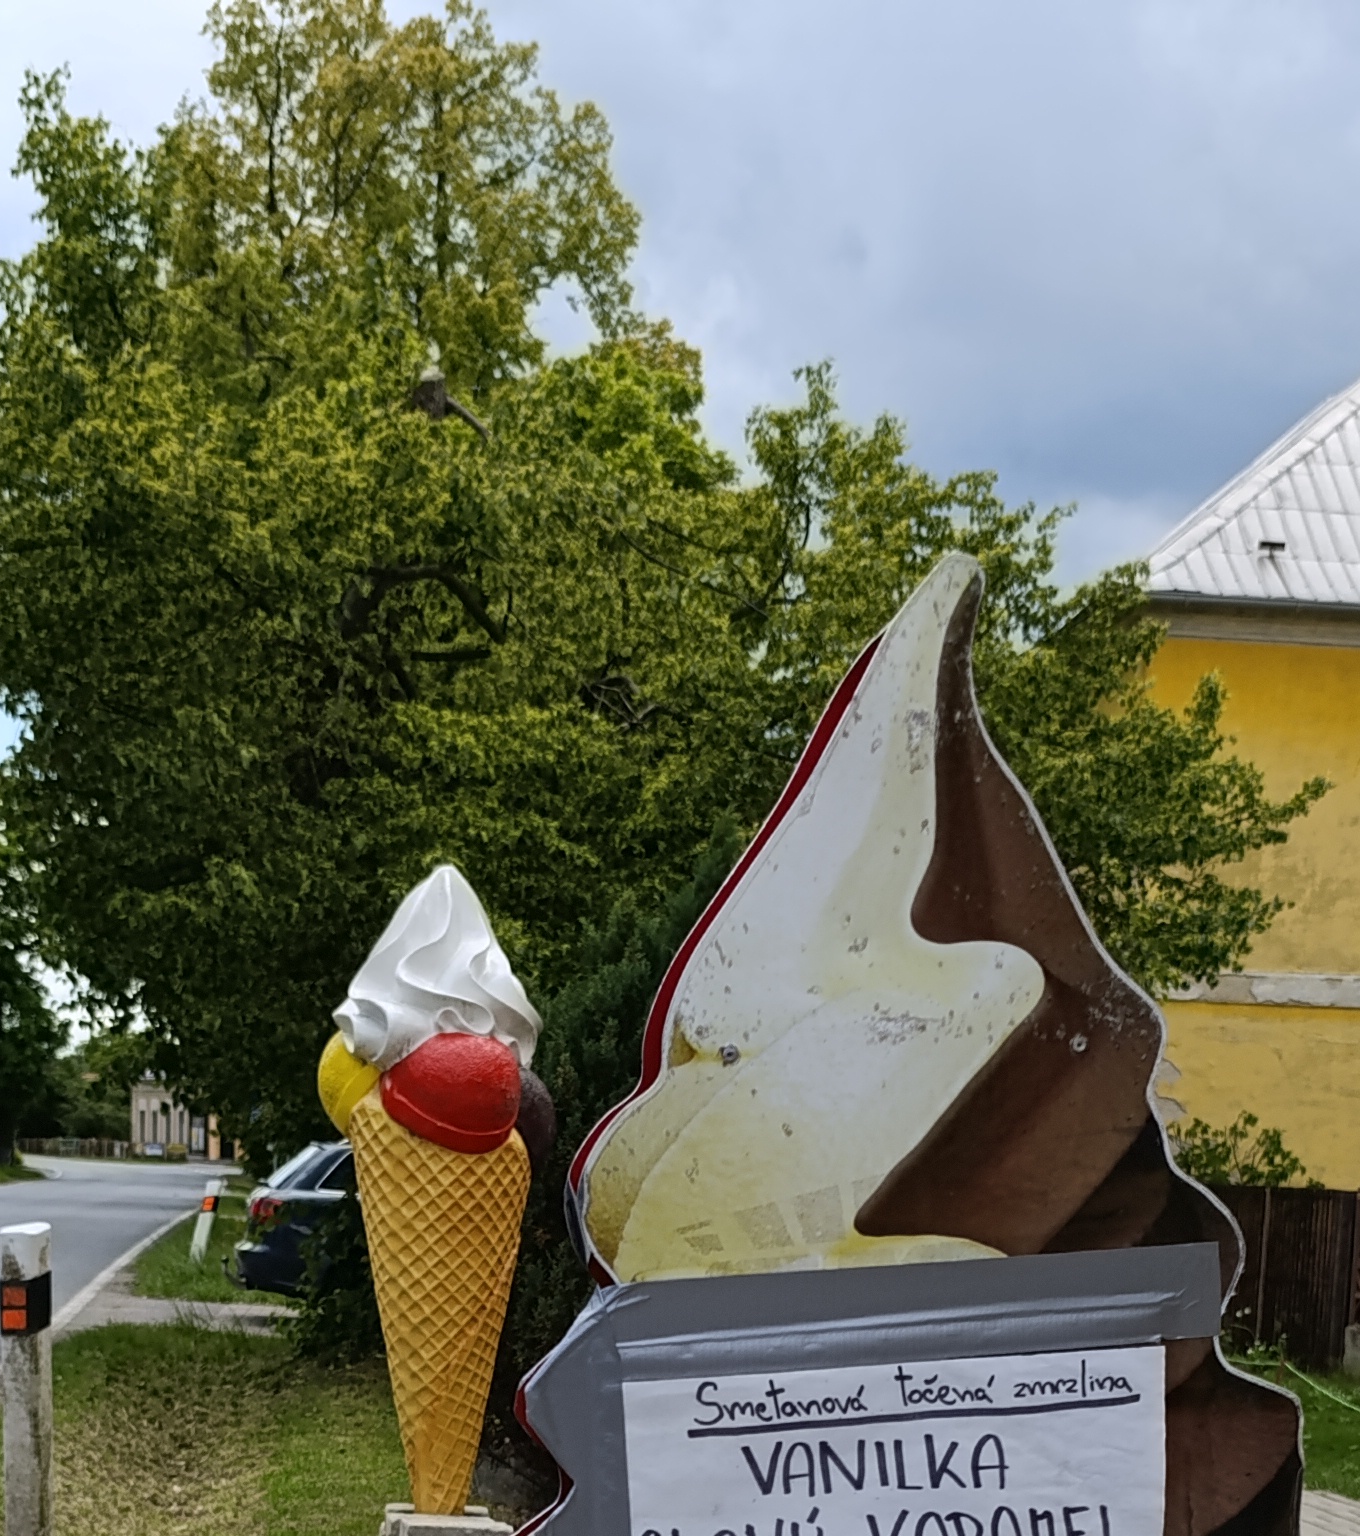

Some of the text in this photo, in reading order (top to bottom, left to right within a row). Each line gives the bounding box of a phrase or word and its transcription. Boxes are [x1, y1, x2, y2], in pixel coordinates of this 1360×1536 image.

[693, 1358, 1134, 1426] Smetanová točená zmrzlina
[740, 1433, 1010, 1498] VANILKA
